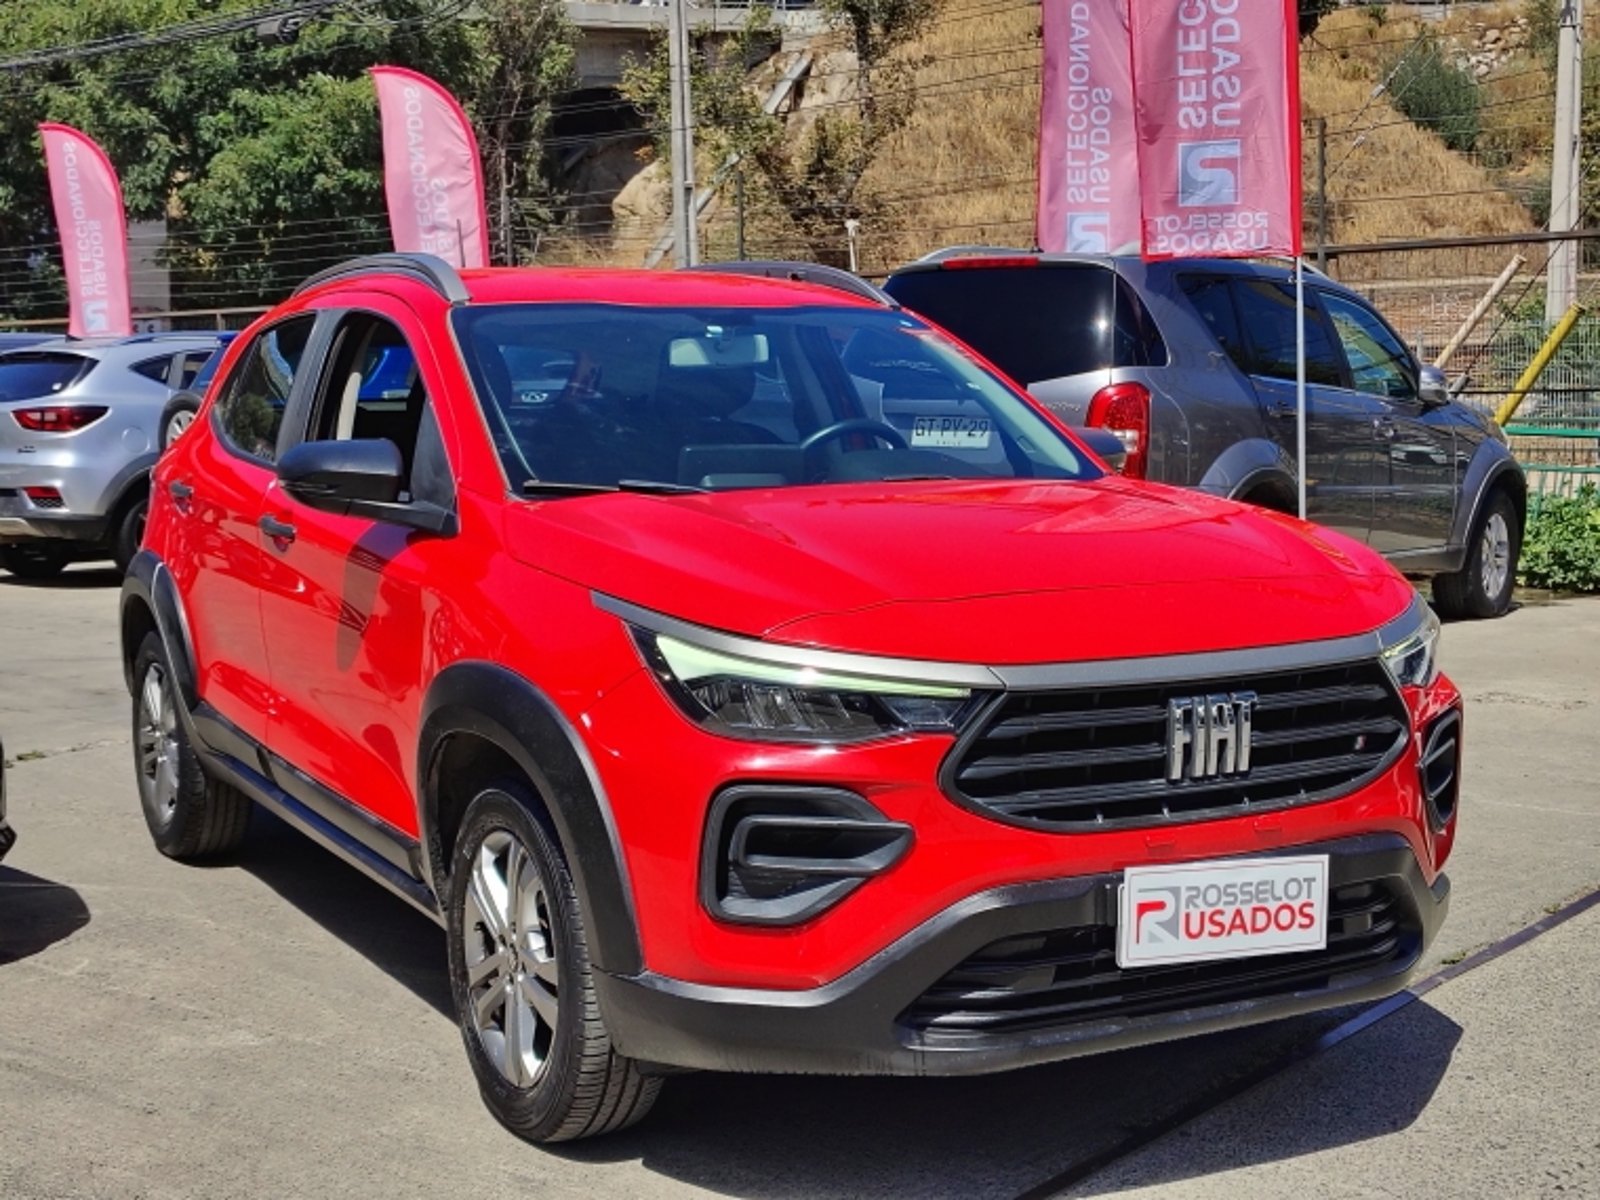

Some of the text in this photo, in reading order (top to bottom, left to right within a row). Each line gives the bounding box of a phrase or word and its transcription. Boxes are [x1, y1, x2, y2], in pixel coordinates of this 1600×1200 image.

[1167, 690, 1258, 780] FIAT
[1185, 877, 1317, 909] ROSSELOT
[1184, 902, 1316, 940] USADOS
